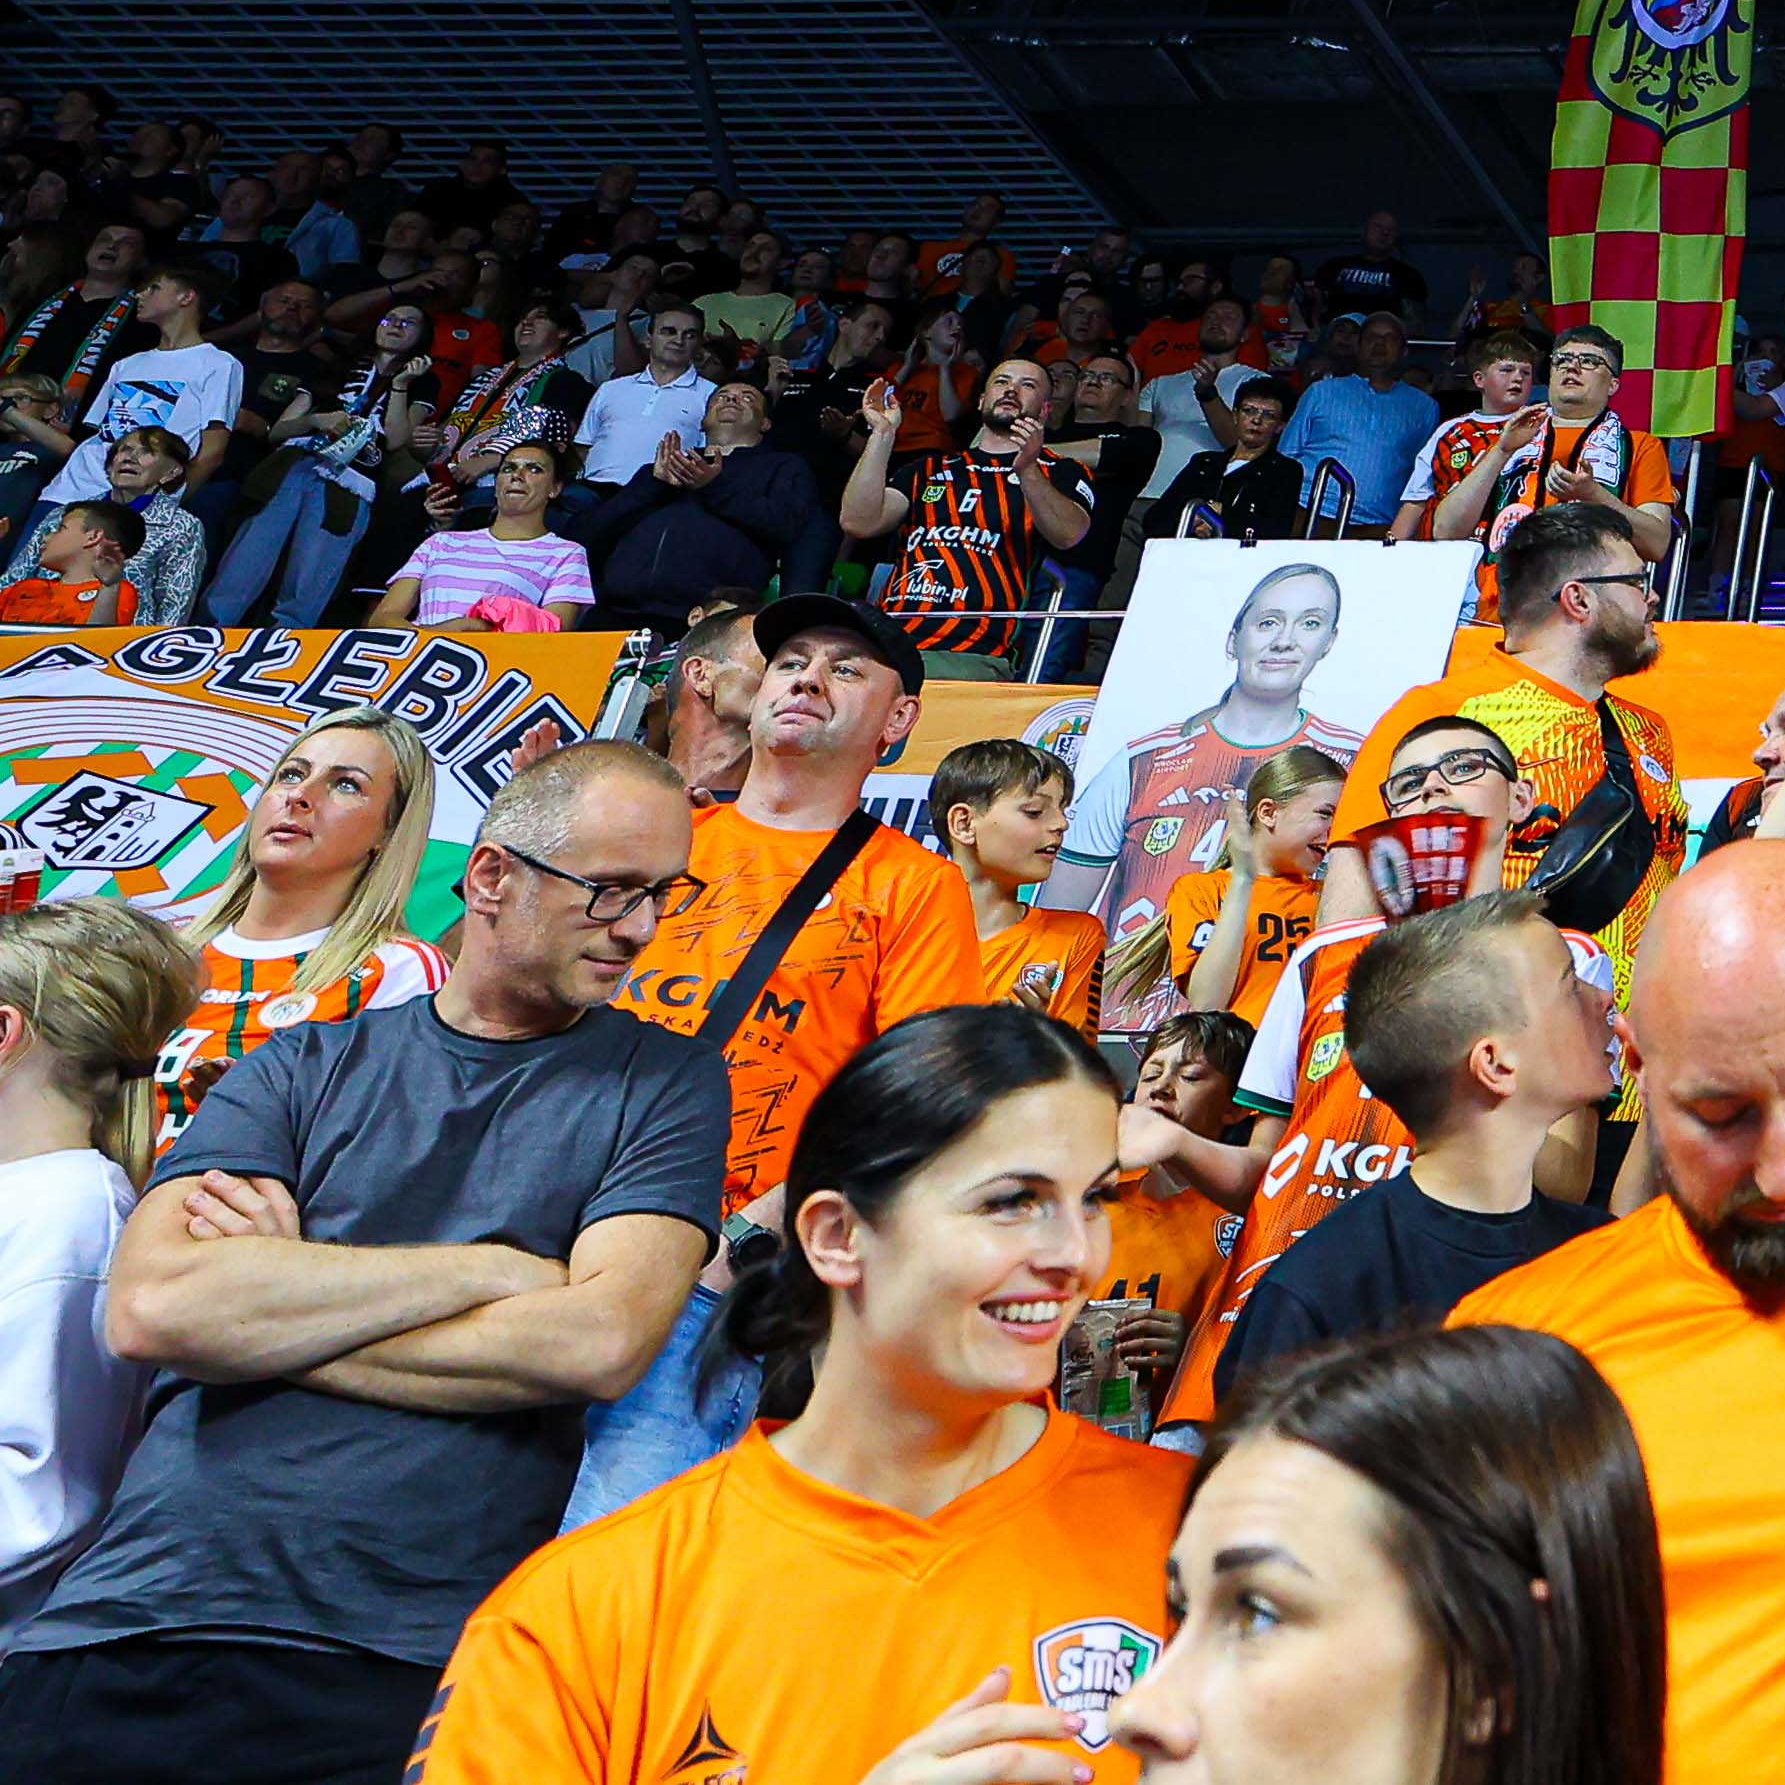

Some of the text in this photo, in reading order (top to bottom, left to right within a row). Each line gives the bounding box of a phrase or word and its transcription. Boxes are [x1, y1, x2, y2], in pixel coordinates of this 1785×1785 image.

[958, 488, 977, 513] 6
[926, 525, 1001, 550] KGHM
[743, 1031, 785, 1055] EDŹ
[1313, 1137, 1413, 1183] KGH
